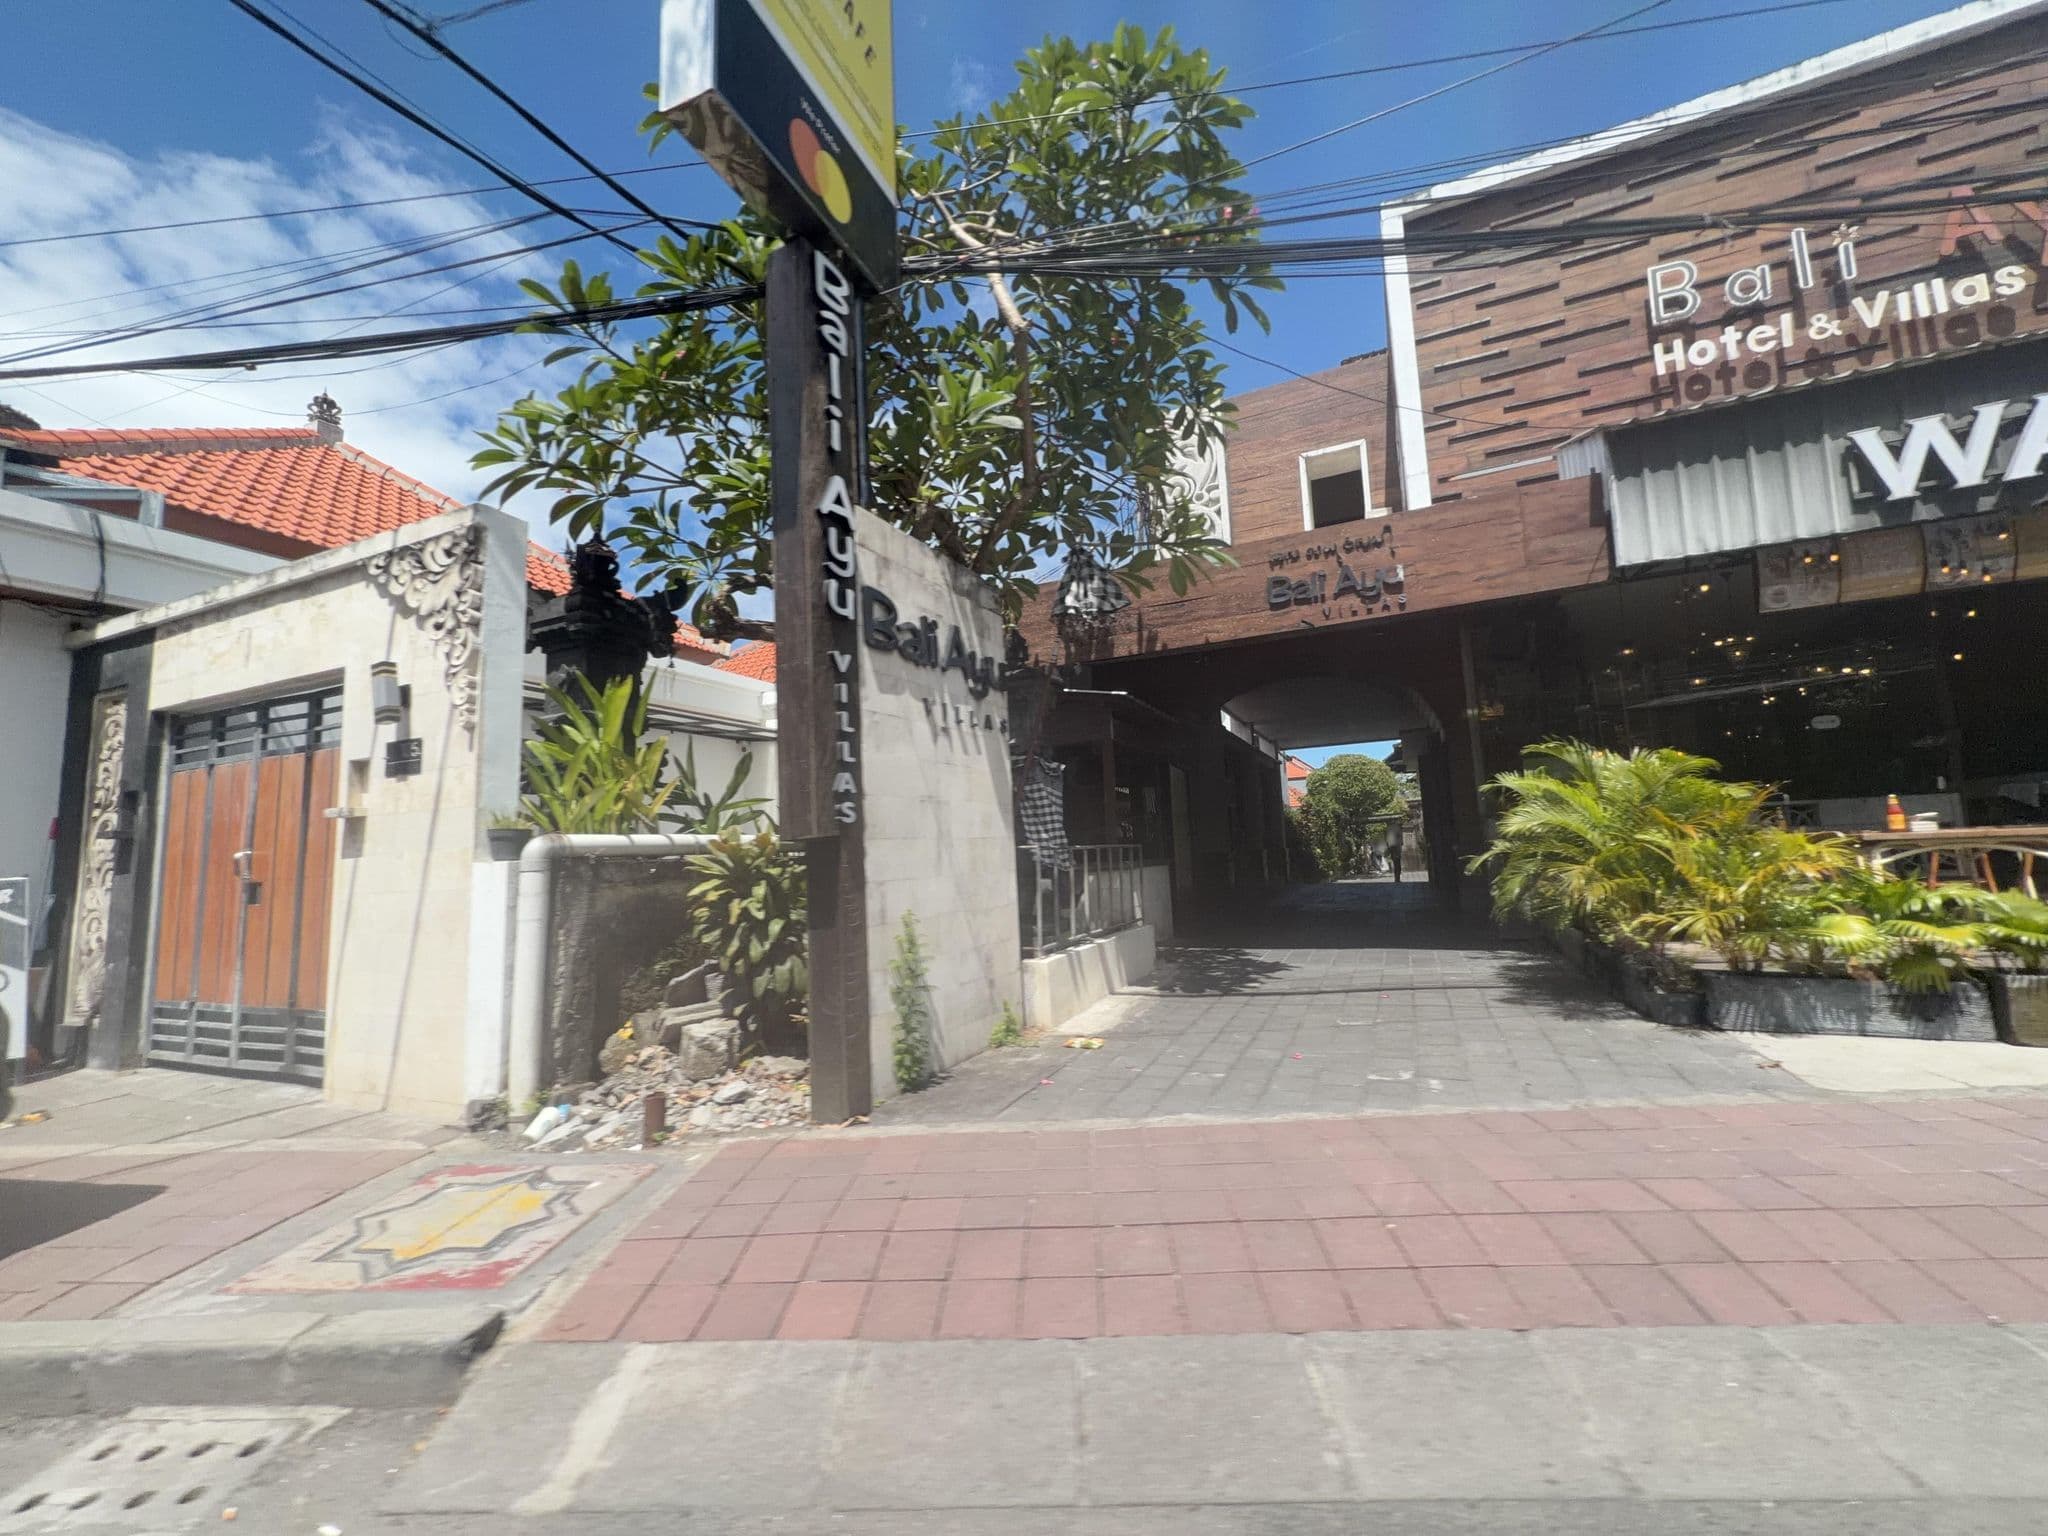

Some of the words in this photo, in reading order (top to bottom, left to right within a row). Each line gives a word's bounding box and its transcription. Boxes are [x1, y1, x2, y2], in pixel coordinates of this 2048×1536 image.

[1647, 224, 1859, 326] Bali
[1652, 312, 1794, 376] Hotel
[1807, 313, 1843, 341] &
[1851, 266, 2028, 330] Villas
[814, 249, 850, 452] Bali
[817, 475, 856, 620] Ayu
[1267, 569, 1327, 604] Bali
[1335, 564, 1405, 602] Ayu
[861, 586, 938, 669] Bali
[940, 624, 1006, 700] Ayu
[828, 650, 858, 823] VILLAS
[922, 697, 1007, 734] VILLAS
